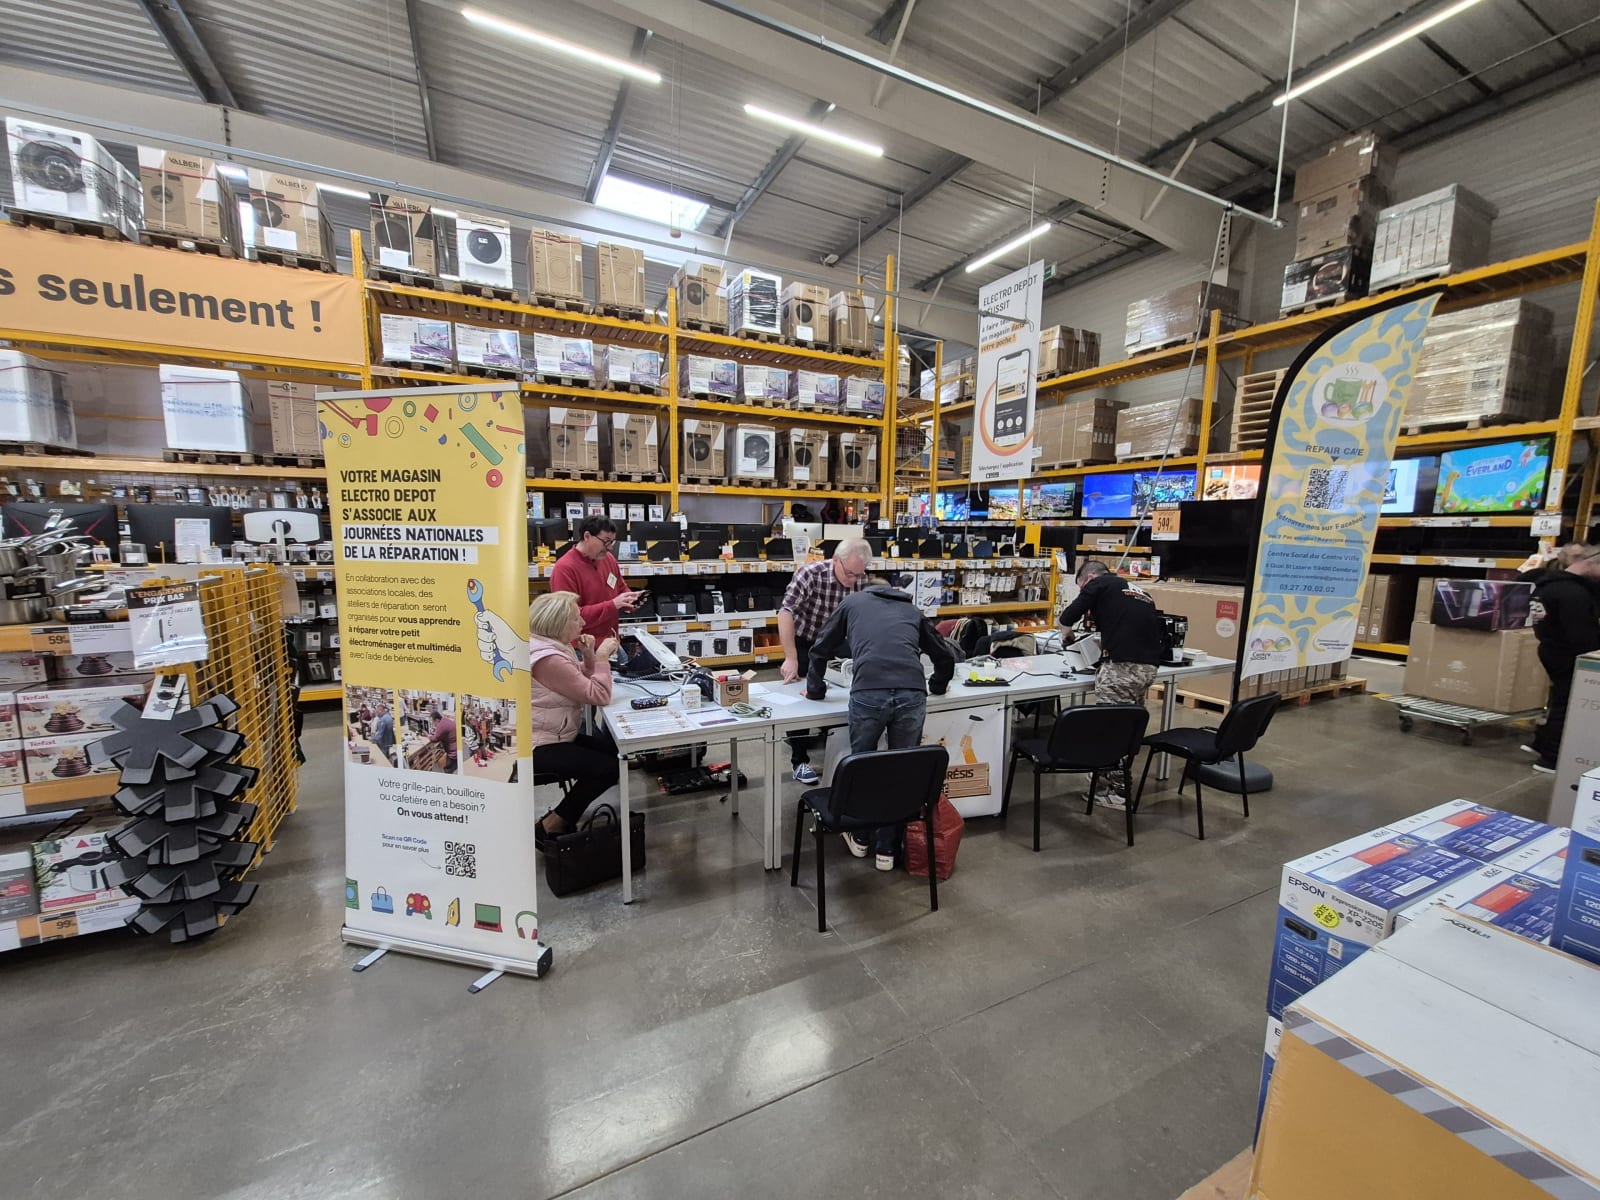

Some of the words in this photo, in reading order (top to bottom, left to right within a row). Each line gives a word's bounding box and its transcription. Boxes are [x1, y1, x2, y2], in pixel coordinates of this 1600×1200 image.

[983, 286, 1013, 306] ELECTRO
[1013, 274, 1038, 293] DEPOT
[38, 273, 296, 330] seulement
[310, 300, 322, 333] !
[1305, 445, 1340, 455] REPAIR
[340, 470, 378, 483] VOTRE
[380, 469, 441, 483] MAGASIN
[341, 489, 390, 502] ELECTRO
[394, 489, 436, 502] DEPOT
[342, 508, 402, 521] S'ASSOCIE
[407, 508, 437, 521] AUX
[343, 524, 401, 540] JOURNÉES
[405, 528, 484, 542] NATIONALES
[344, 546, 358, 558] DE
[361, 546, 376, 559] LA
[379, 543, 459, 561] RÉPARATION
[462, 548, 467, 561] !
[345, 573, 355, 582] En
[356, 573, 399, 584] collaboration
[400, 577, 420, 585] avec
[420, 576, 436, 585] des
[129, 586, 194, 599] L'ENGAGEMENT
[143, 596, 166, 605] PRIX
[167, 593, 185, 602] BAS
[346, 588, 387, 597] associations
[387, 589, 417, 598] locales,
[418, 589, 434, 599] des
[347, 600, 371, 609] ateliers
[371, 601, 380, 609] de
[380, 603, 420, 612] réparation
[422, 604, 447, 613] seront
[347, 613, 379, 623] organisés
[379, 615, 396, 624] pour
[397, 616, 418, 624] vous
[418, 617, 461, 627] apprendre
[353, 627, 378, 636] réparer
[379, 629, 400, 637] votre
[401, 629, 420, 638] petit
[348, 639, 406, 651] électroménager
[407, 642, 416, 650] et
[416, 642, 462, 653] multimédia
[382, 654, 393, 662] de
[393, 653, 435, 664] bénévoles.
[947, 768, 974, 780] RÉSIS
[378, 777, 401, 790] Votre
[402, 782, 445, 795] grille-pain,
[446, 786, 486, 800] bouilloire
[379, 793, 391, 801] ou
[391, 794, 429, 806] cafetière
[429, 799, 441, 807] en
[449, 800, 479, 812] besoin
[396, 806, 410, 817] On
[411, 810, 433, 820] vous
[434, 812, 464, 824] attend
[382, 841, 395, 849] pour
[412, 837, 427, 845] Code
[1287, 875, 1326, 899] EPSON
[1331, 894, 1364, 914] Expression
[1364, 909, 1385, 923] Home
